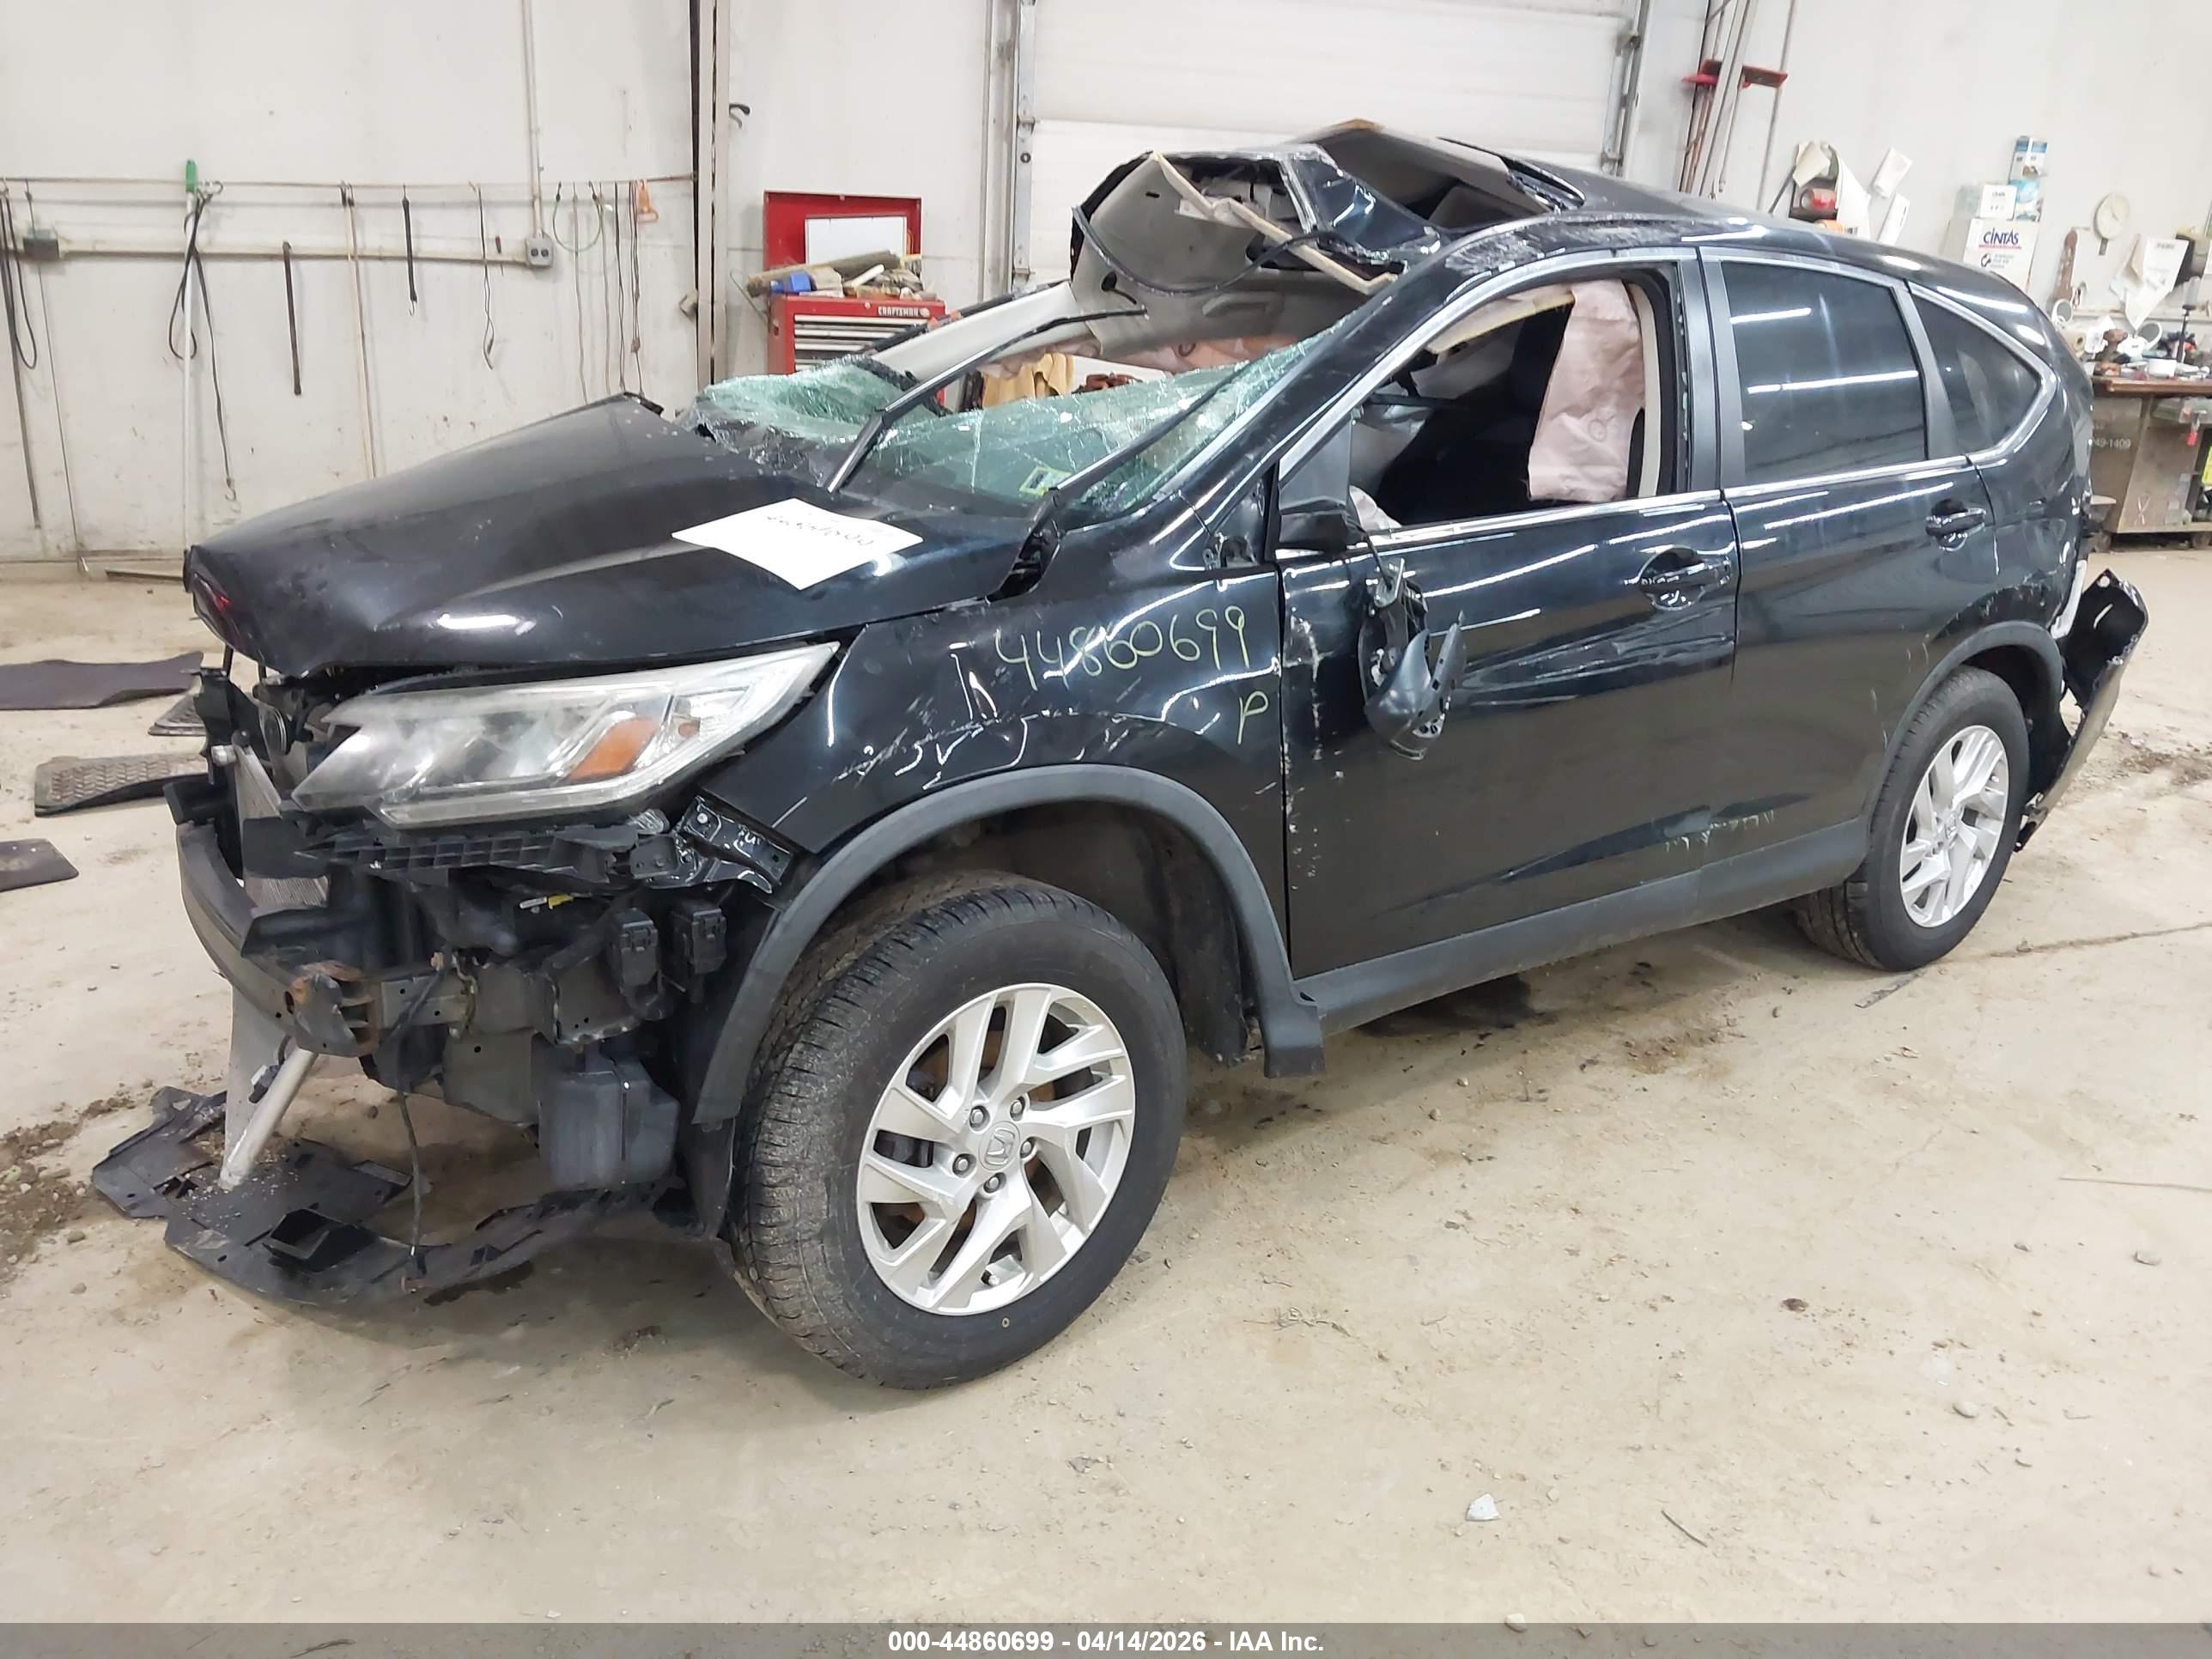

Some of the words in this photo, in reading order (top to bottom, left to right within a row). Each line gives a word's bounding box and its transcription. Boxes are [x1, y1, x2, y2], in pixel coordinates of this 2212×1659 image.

[1983, 226, 2019, 246] CINTAS
[878, 306, 919, 317] CRAFTSMAN
[994, 605, 1250, 691] 44860699
[1237, 690, 1269, 745] P
